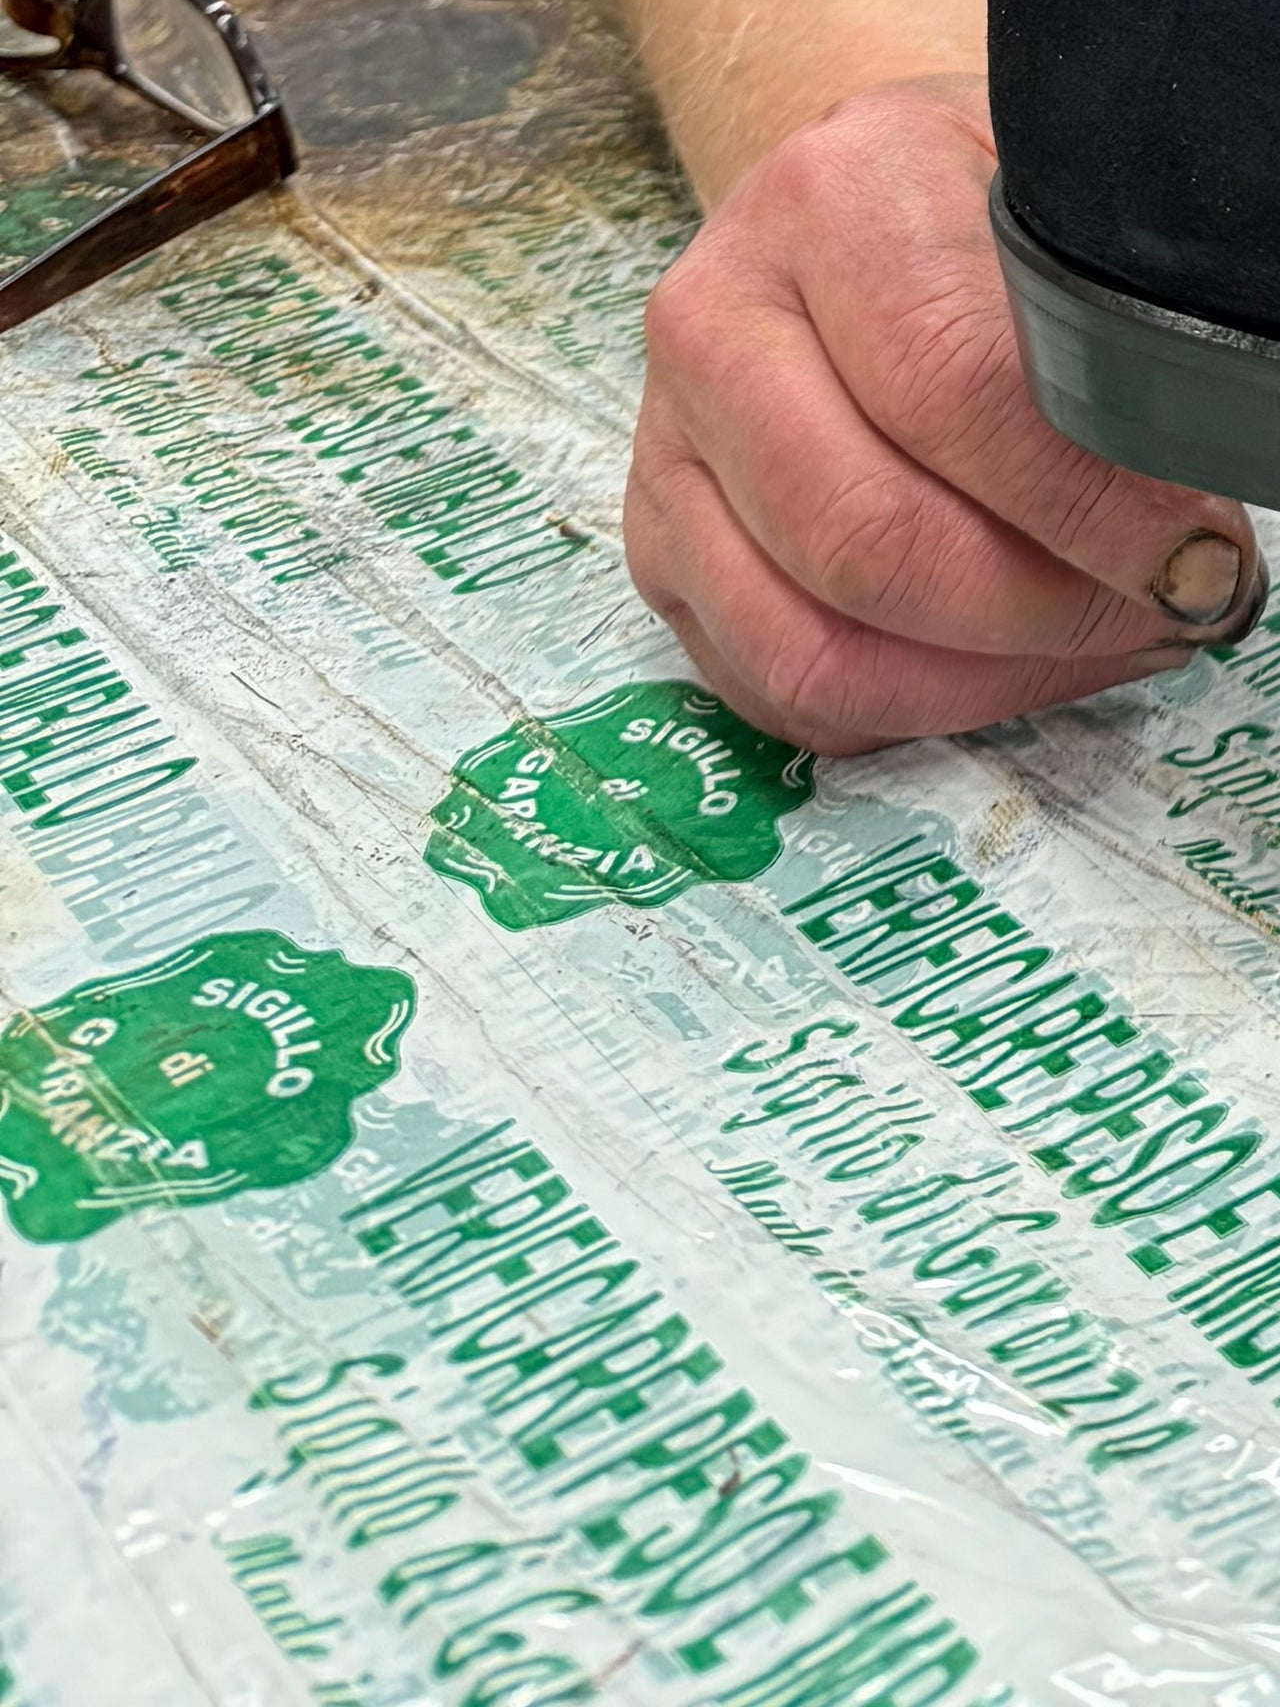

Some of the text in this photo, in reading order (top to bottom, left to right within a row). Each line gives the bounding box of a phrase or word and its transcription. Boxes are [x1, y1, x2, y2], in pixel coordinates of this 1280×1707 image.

[48, 426, 134, 482] Made
[66, 349, 224, 438] Sigillo
[266, 363, 452, 461] PESO
[337, 425, 476, 484] E
[357, 444, 593, 596] IMBALLO
[600, 777, 650, 802] di
[619, 718, 743, 818] SIGILLO
[157, 1050, 216, 1088] di
[191, 977, 322, 1099] SIGILLO
[780, 833, 1141, 1113] VERIFICARE
[1003, 1048, 1269, 1229] PESO
[703, 1158, 834, 1257] Made
[720, 1016, 938, 1182] Sigillo
[911, 1209, 1201, 1476] Garanzia
[339, 1117, 726, 1470] VERIFICARE
[233, 1352, 480, 1551] Sigillo
[551, 1386, 844, 1617] PESO
[210, 1532, 345, 1660] Made
[675, 1532, 894, 1675] E
